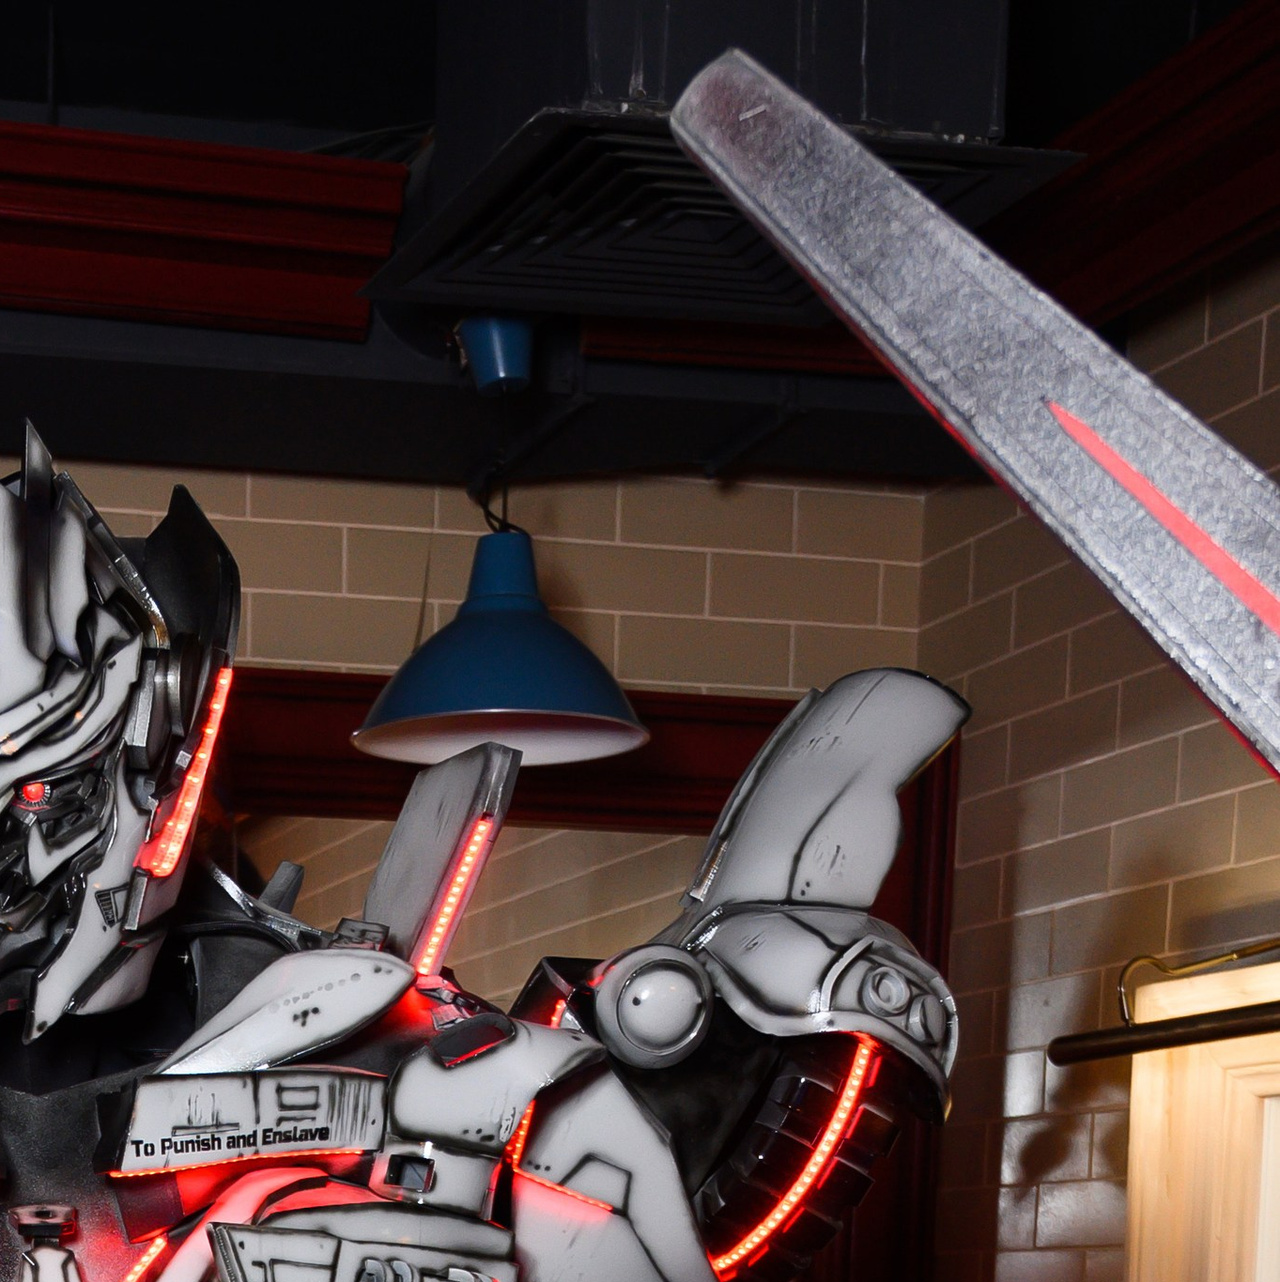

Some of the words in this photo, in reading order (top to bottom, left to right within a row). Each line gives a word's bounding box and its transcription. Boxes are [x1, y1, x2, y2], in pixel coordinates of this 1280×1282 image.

[131, 1139, 156, 1157] To
[161, 1134, 222, 1155] Punish
[226, 1130, 257, 1149] and
[261, 1126, 330, 1146] Enslave
